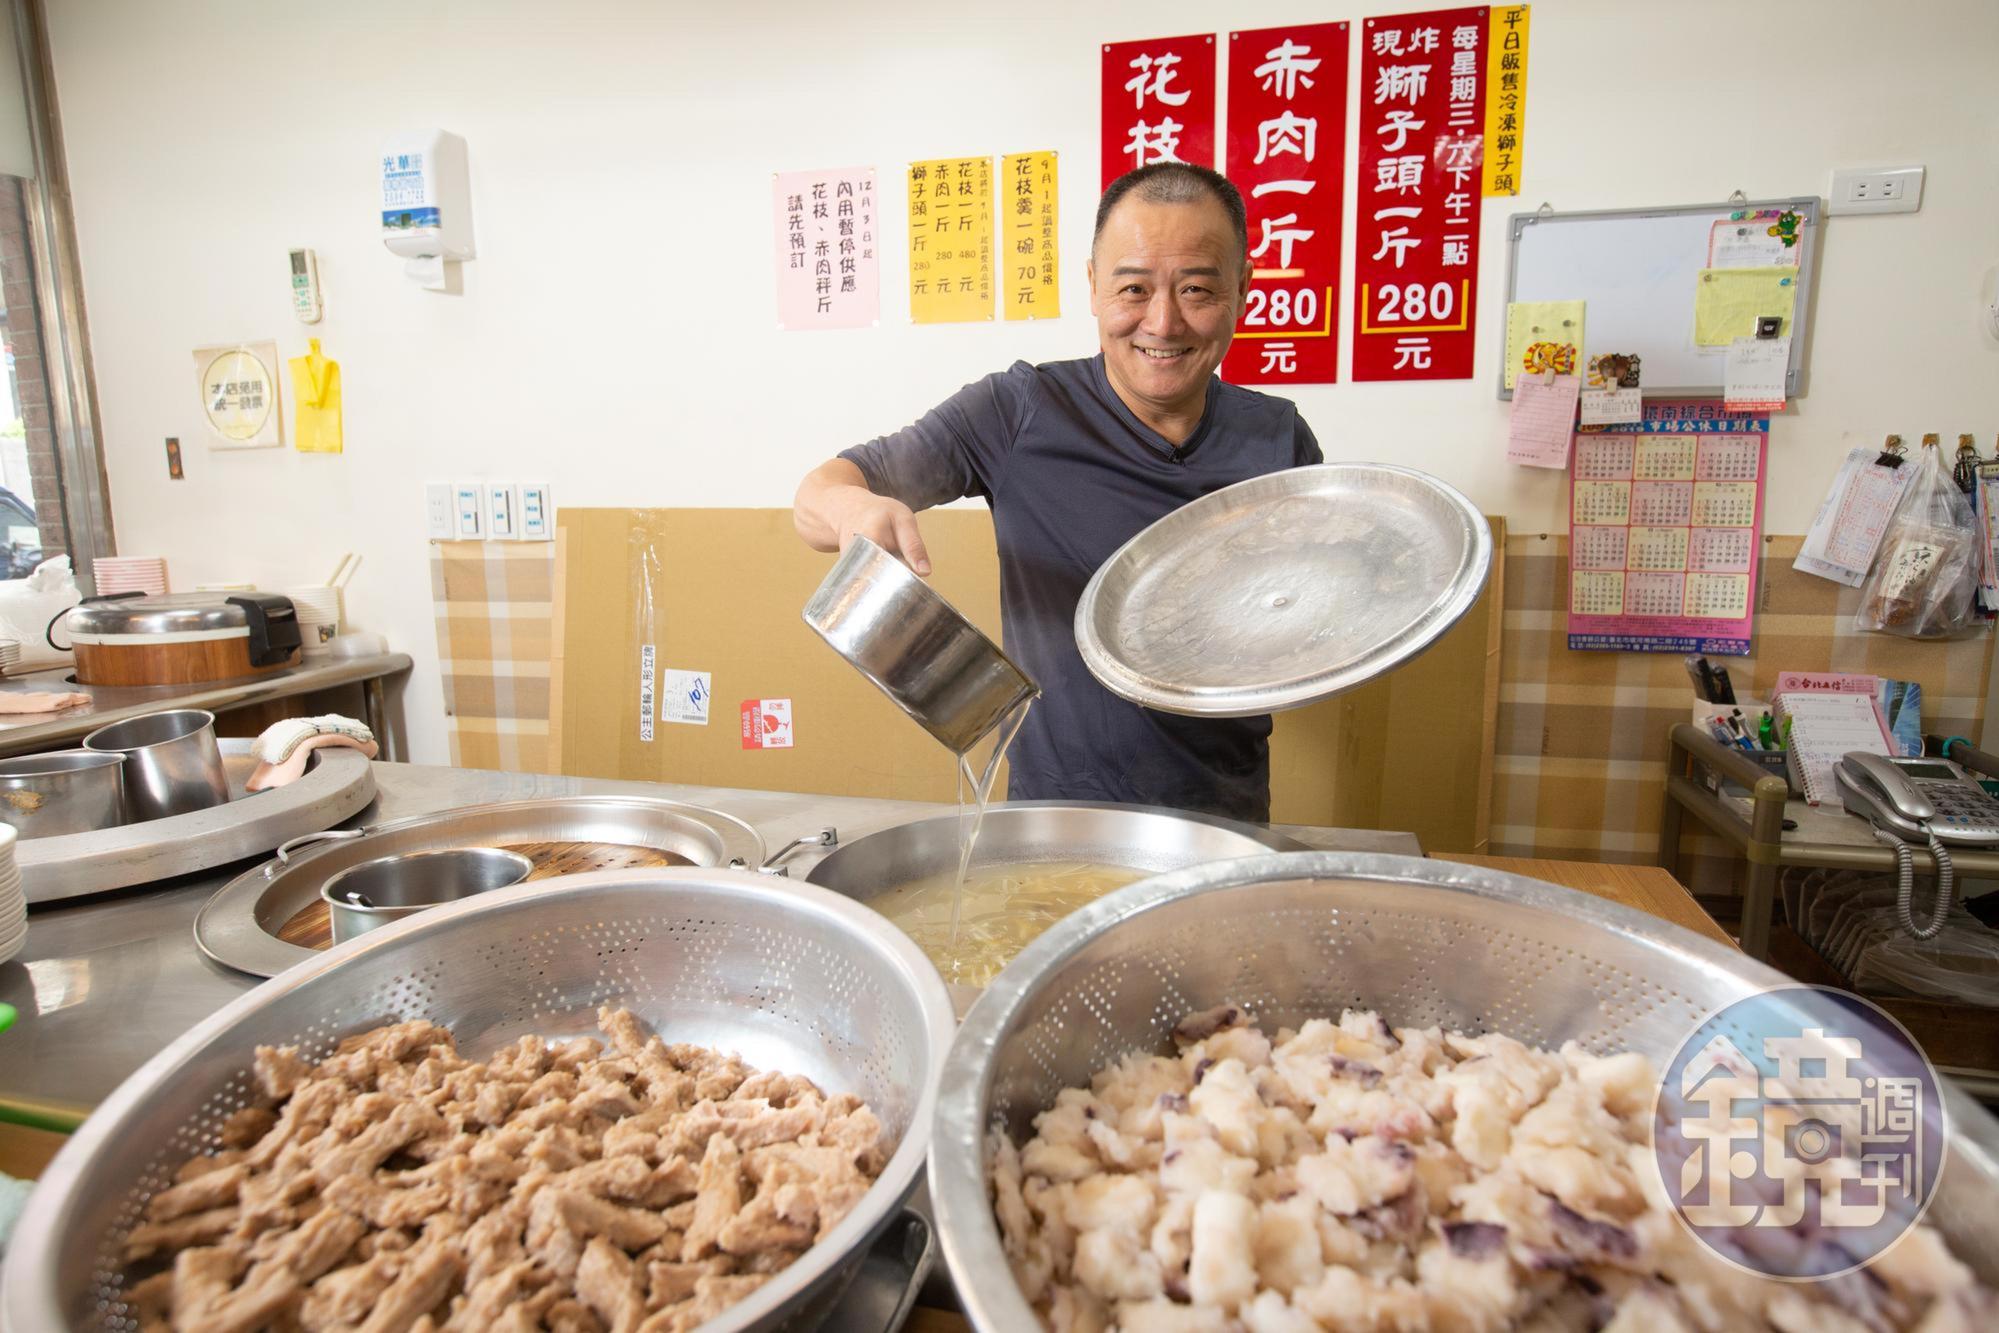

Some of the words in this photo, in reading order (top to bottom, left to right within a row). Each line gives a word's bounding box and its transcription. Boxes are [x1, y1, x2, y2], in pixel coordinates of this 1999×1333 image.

[1123, 52, 1191, 168] 花枝
[1494, 10, 1522, 191] 平日販售冷凍獅子頭
[1250, 39, 1321, 270] 赤肉一斤
[787, 194, 806, 268] 請先預訂
[1244, 289, 1317, 326] 280
[1377, 281, 1453, 323] 280
[1260, 342, 1297, 373] 元
[1392, 337, 1431, 371] 元
